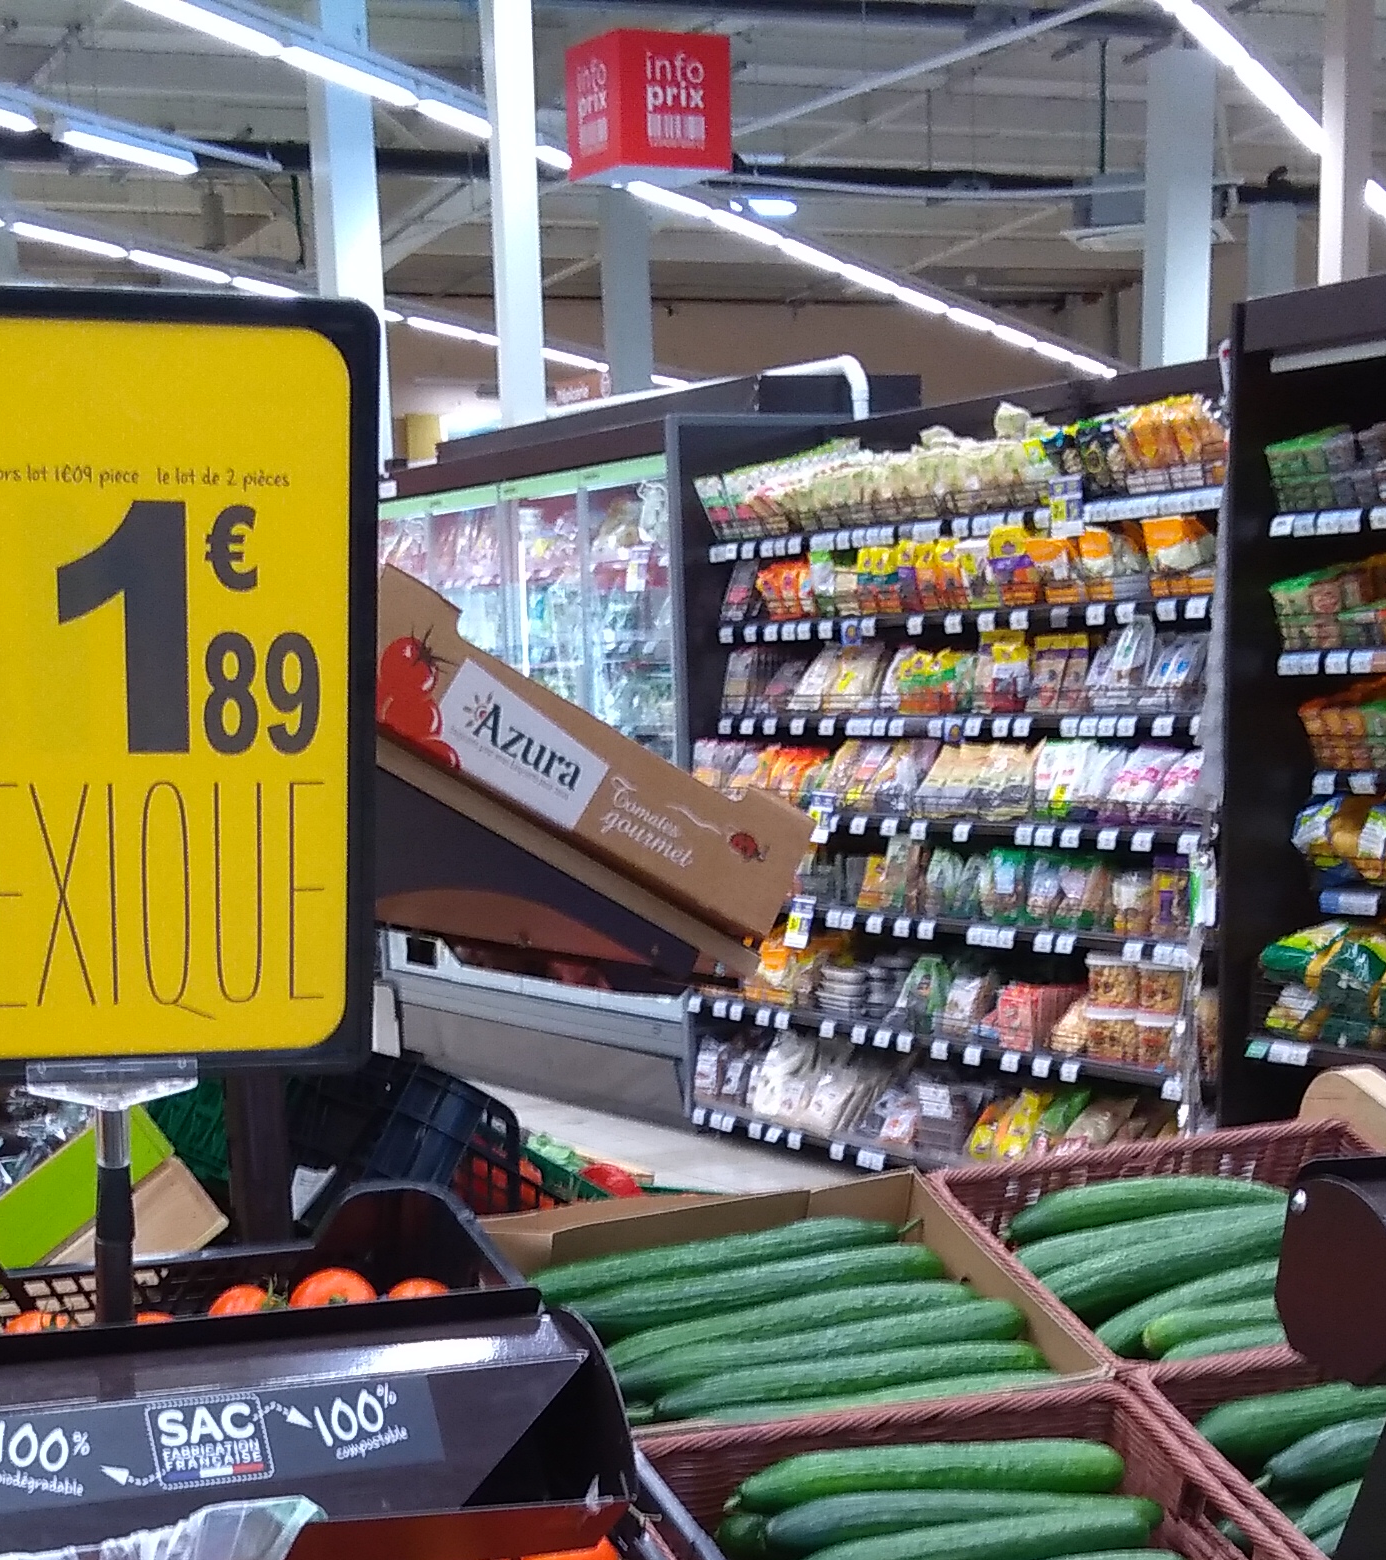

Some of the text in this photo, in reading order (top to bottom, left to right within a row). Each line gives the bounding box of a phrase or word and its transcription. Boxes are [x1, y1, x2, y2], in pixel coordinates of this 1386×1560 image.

[576, 58, 606, 89] info
[645, 50, 704, 82] info
[578, 90, 607, 117] prix
[646, 79, 704, 110] prix
[27, 464, 47, 483] lot
[202, 466, 220, 486] de
[226, 468, 238, 486] 2
[57, 500, 259, 755] 1 €
[203, 631, 321, 756] 89
[472, 702, 582, 792] Azura
[158, 1403, 255, 1447] SAC
[314, 1383, 397, 1446] 100%
